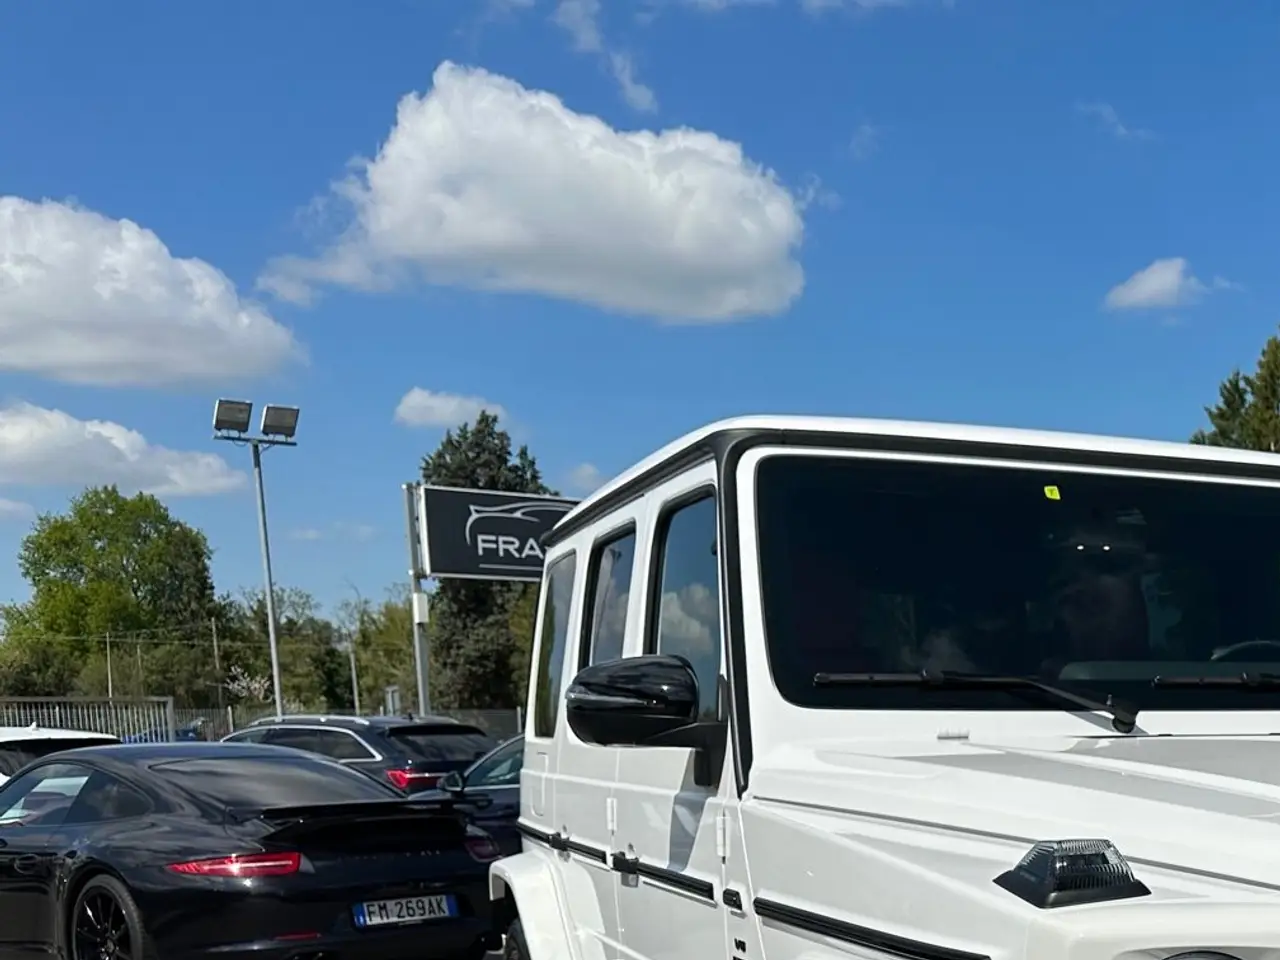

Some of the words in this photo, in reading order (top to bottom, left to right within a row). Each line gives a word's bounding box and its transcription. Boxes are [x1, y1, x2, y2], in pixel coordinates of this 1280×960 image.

[477, 533, 549, 560] FRA
[366, 901, 390, 922] FM
[394, 895, 447, 919] 269AK
